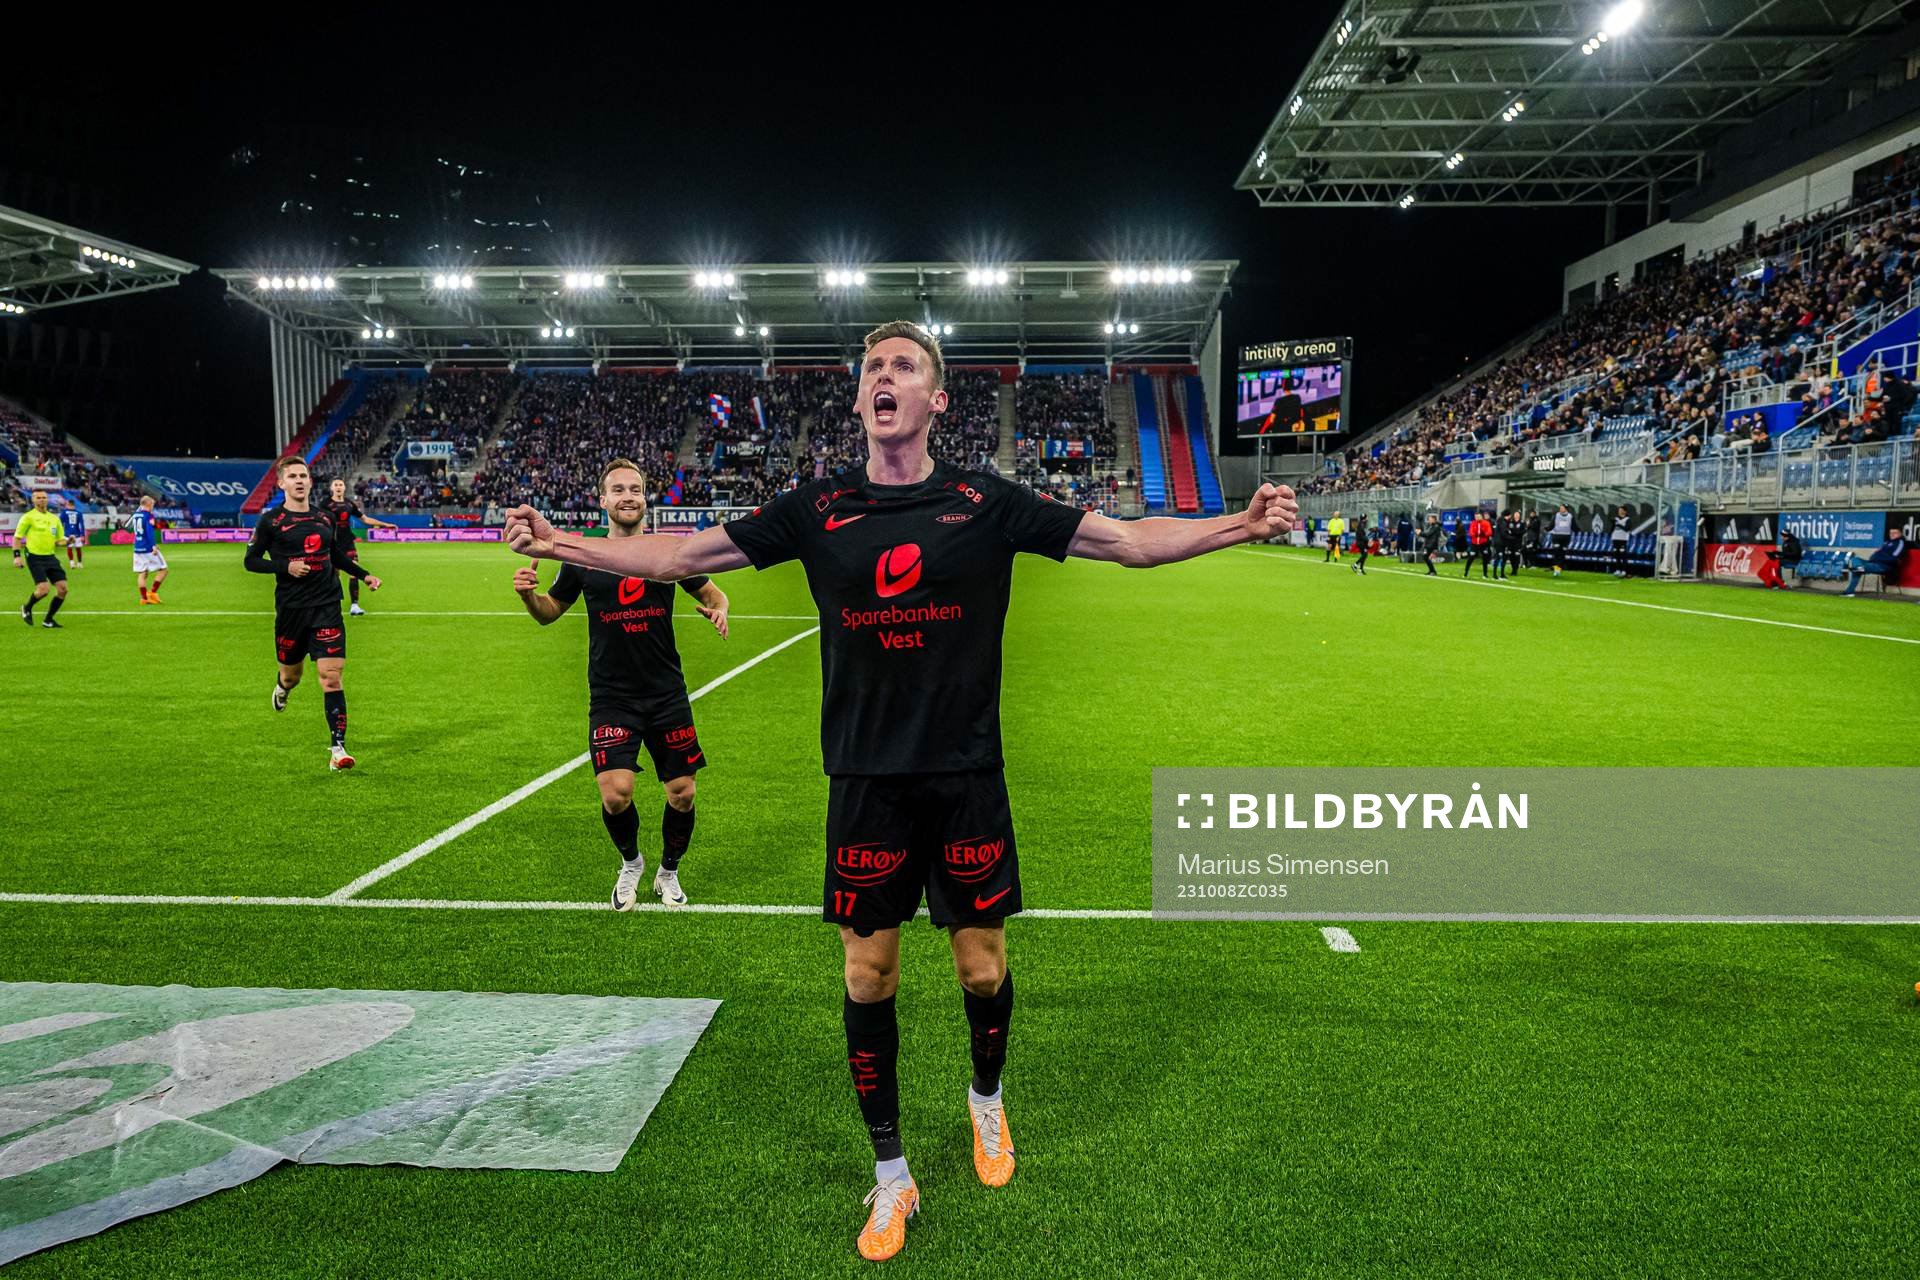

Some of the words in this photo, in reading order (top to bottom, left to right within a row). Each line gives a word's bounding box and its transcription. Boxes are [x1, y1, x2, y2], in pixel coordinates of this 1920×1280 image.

[1244, 342, 1289, 361] intility
[1294, 342, 1336, 356] arena
[426, 444, 451, 455] 1991
[186, 482, 249, 496] OBOS
[580, 511, 600, 521] VAR
[942, 514, 967, 522] BRANN
[600, 605, 666, 625] Sparebanken
[841, 600, 962, 632] Sparebanken
[622, 621, 649, 634] Vest
[878, 630, 925, 650] Vest
[593, 726, 630, 740] LERØY
[665, 725, 696, 744] LERØ
[595, 749, 607, 768] 11
[837, 847, 901, 870] LERØY
[945, 840, 1001, 865] LERØY
[834, 890, 858, 917] 17
